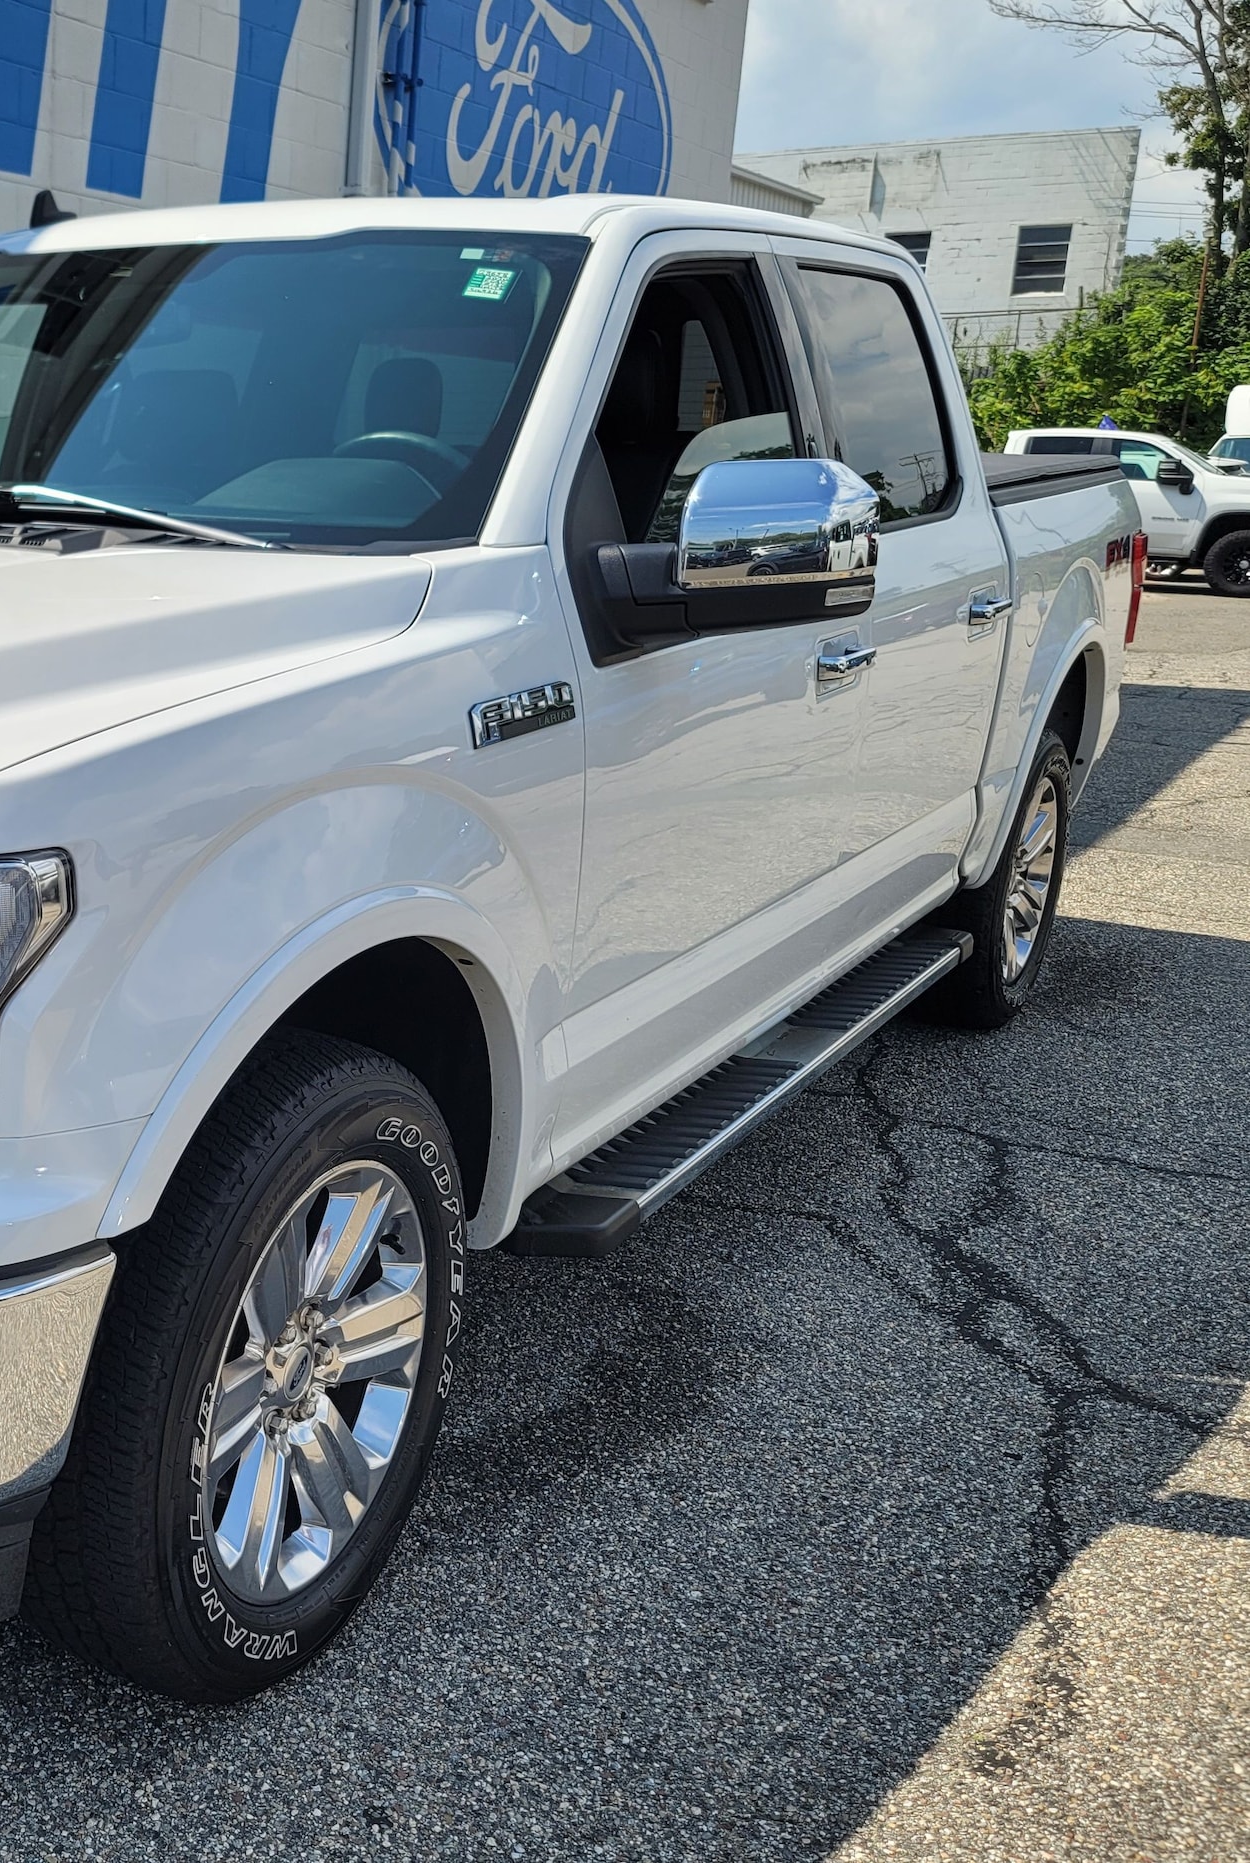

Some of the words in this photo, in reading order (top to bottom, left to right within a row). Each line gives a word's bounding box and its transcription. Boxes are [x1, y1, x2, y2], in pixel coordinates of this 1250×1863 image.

[446, 0, 625, 198] Ford
[536, 709, 571, 728] LARIAT
[376, 1117, 464, 1399] GOODYEAR
[190, 1381, 298, 1661] WRANGLER
